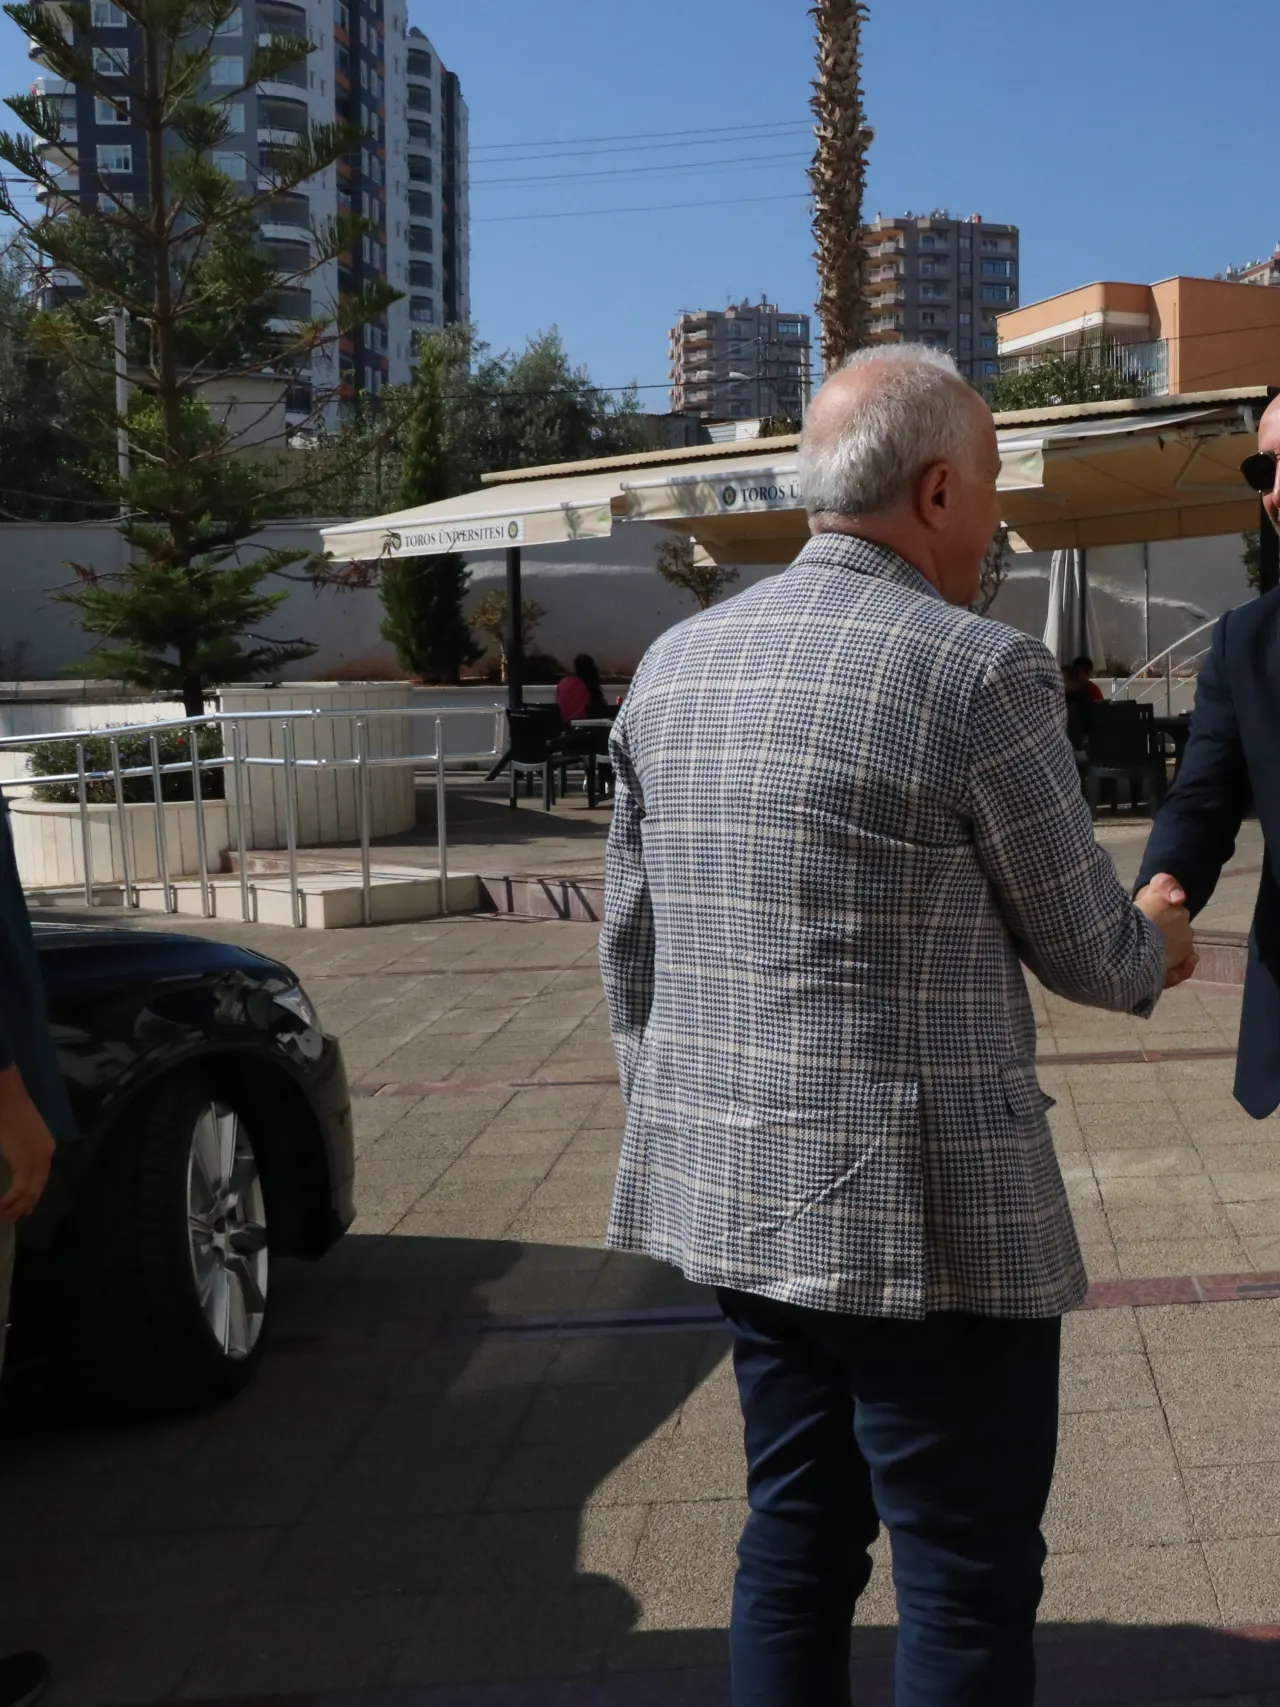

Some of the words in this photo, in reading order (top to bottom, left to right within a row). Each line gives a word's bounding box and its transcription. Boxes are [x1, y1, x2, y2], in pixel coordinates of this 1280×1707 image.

[741, 484, 785, 503] TOROS
[404, 533, 436, 548] TOROS
[438, 522, 505, 545] ÜNİVERSİTESİ
